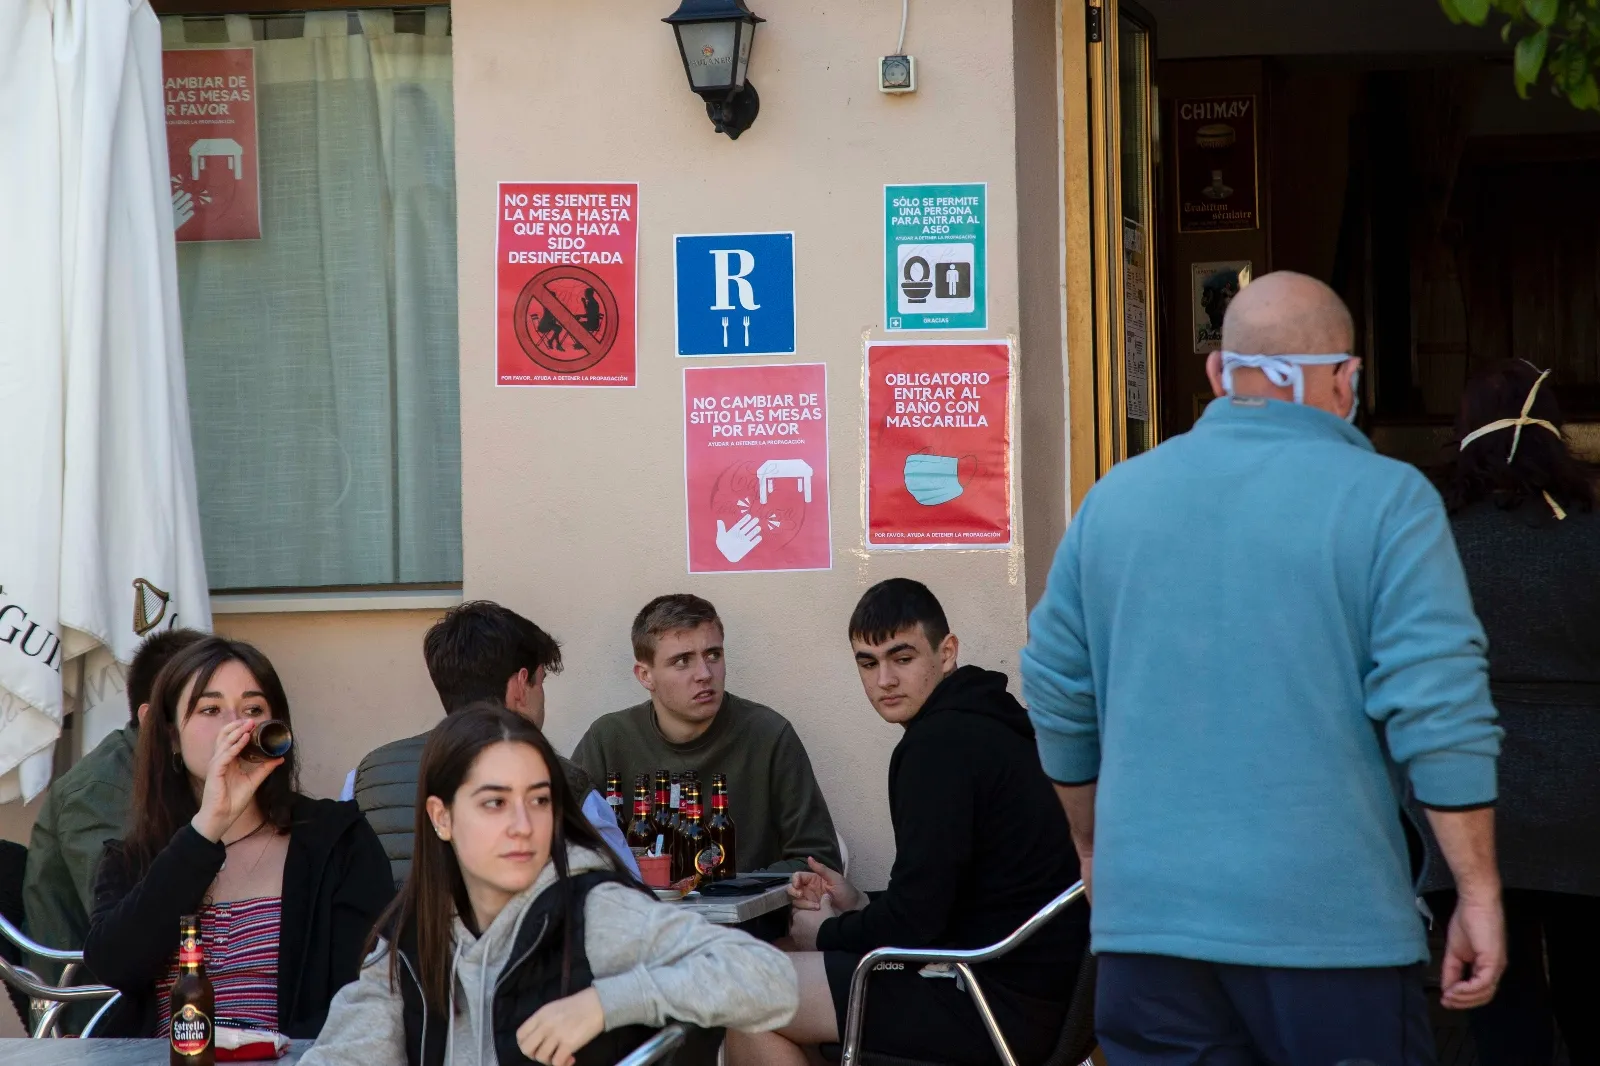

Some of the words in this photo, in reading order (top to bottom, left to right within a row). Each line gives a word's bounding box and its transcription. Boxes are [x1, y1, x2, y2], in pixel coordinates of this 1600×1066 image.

[165, 76, 224, 89] AMBIAR
[228, 76, 247, 88] DE
[168, 90, 196, 102] LAS
[200, 90, 250, 102] MESAS
[166, 104, 176, 116] R
[180, 104, 230, 116] FAVOR
[1180, 100, 1250, 120] CHIMAY
[504, 194, 528, 207] NO
[532, 194, 551, 207] SE
[554, 194, 607, 207] SIENTE
[610, 194, 631, 207] EN
[893, 196, 920, 207] SÓLO
[922, 198, 934, 206] SE
[936, 197, 979, 206] PERMITE
[1184, 202, 1228, 212] Tradition
[504, 209, 525, 221] LA
[529, 209, 573, 221] MESA
[577, 209, 630, 221] HASTA
[900, 207, 921, 216] UNA
[924, 206, 972, 216] PERSONA
[892, 217, 920, 226] PARA
[923, 216, 963, 225] ENTRAR
[966, 216, 980, 224] AL
[513, 223, 544, 236] QUE
[548, 223, 572, 236] NO
[576, 223, 620, 236] HAYA
[922, 226, 950, 234] ASEO
[547, 237, 586, 250] SIDO
[508, 251, 623, 264] DESINFECTADA
[709, 249, 761, 310] R
[885, 373, 990, 386] OBLIGATORIO
[894, 387, 956, 400] ENTRAR
[961, 387, 981, 399] AL
[693, 397, 716, 410] NO
[720, 394, 794, 408] CAMBIAR
[799, 393, 818, 406] DE
[895, 398, 941, 414] BAÑO
[945, 401, 979, 414] CON
[690, 411, 730, 424] SITIO
[735, 410, 764, 423] LAS
[768, 408, 822, 422] MESAS
[886, 415, 989, 428] MASCARILLA
[712, 425, 744, 437] POR
[748, 423, 800, 436] FAVOR
[174, 1021, 205, 1031] Estrella
[174, 1030, 204, 1041] Galicia
